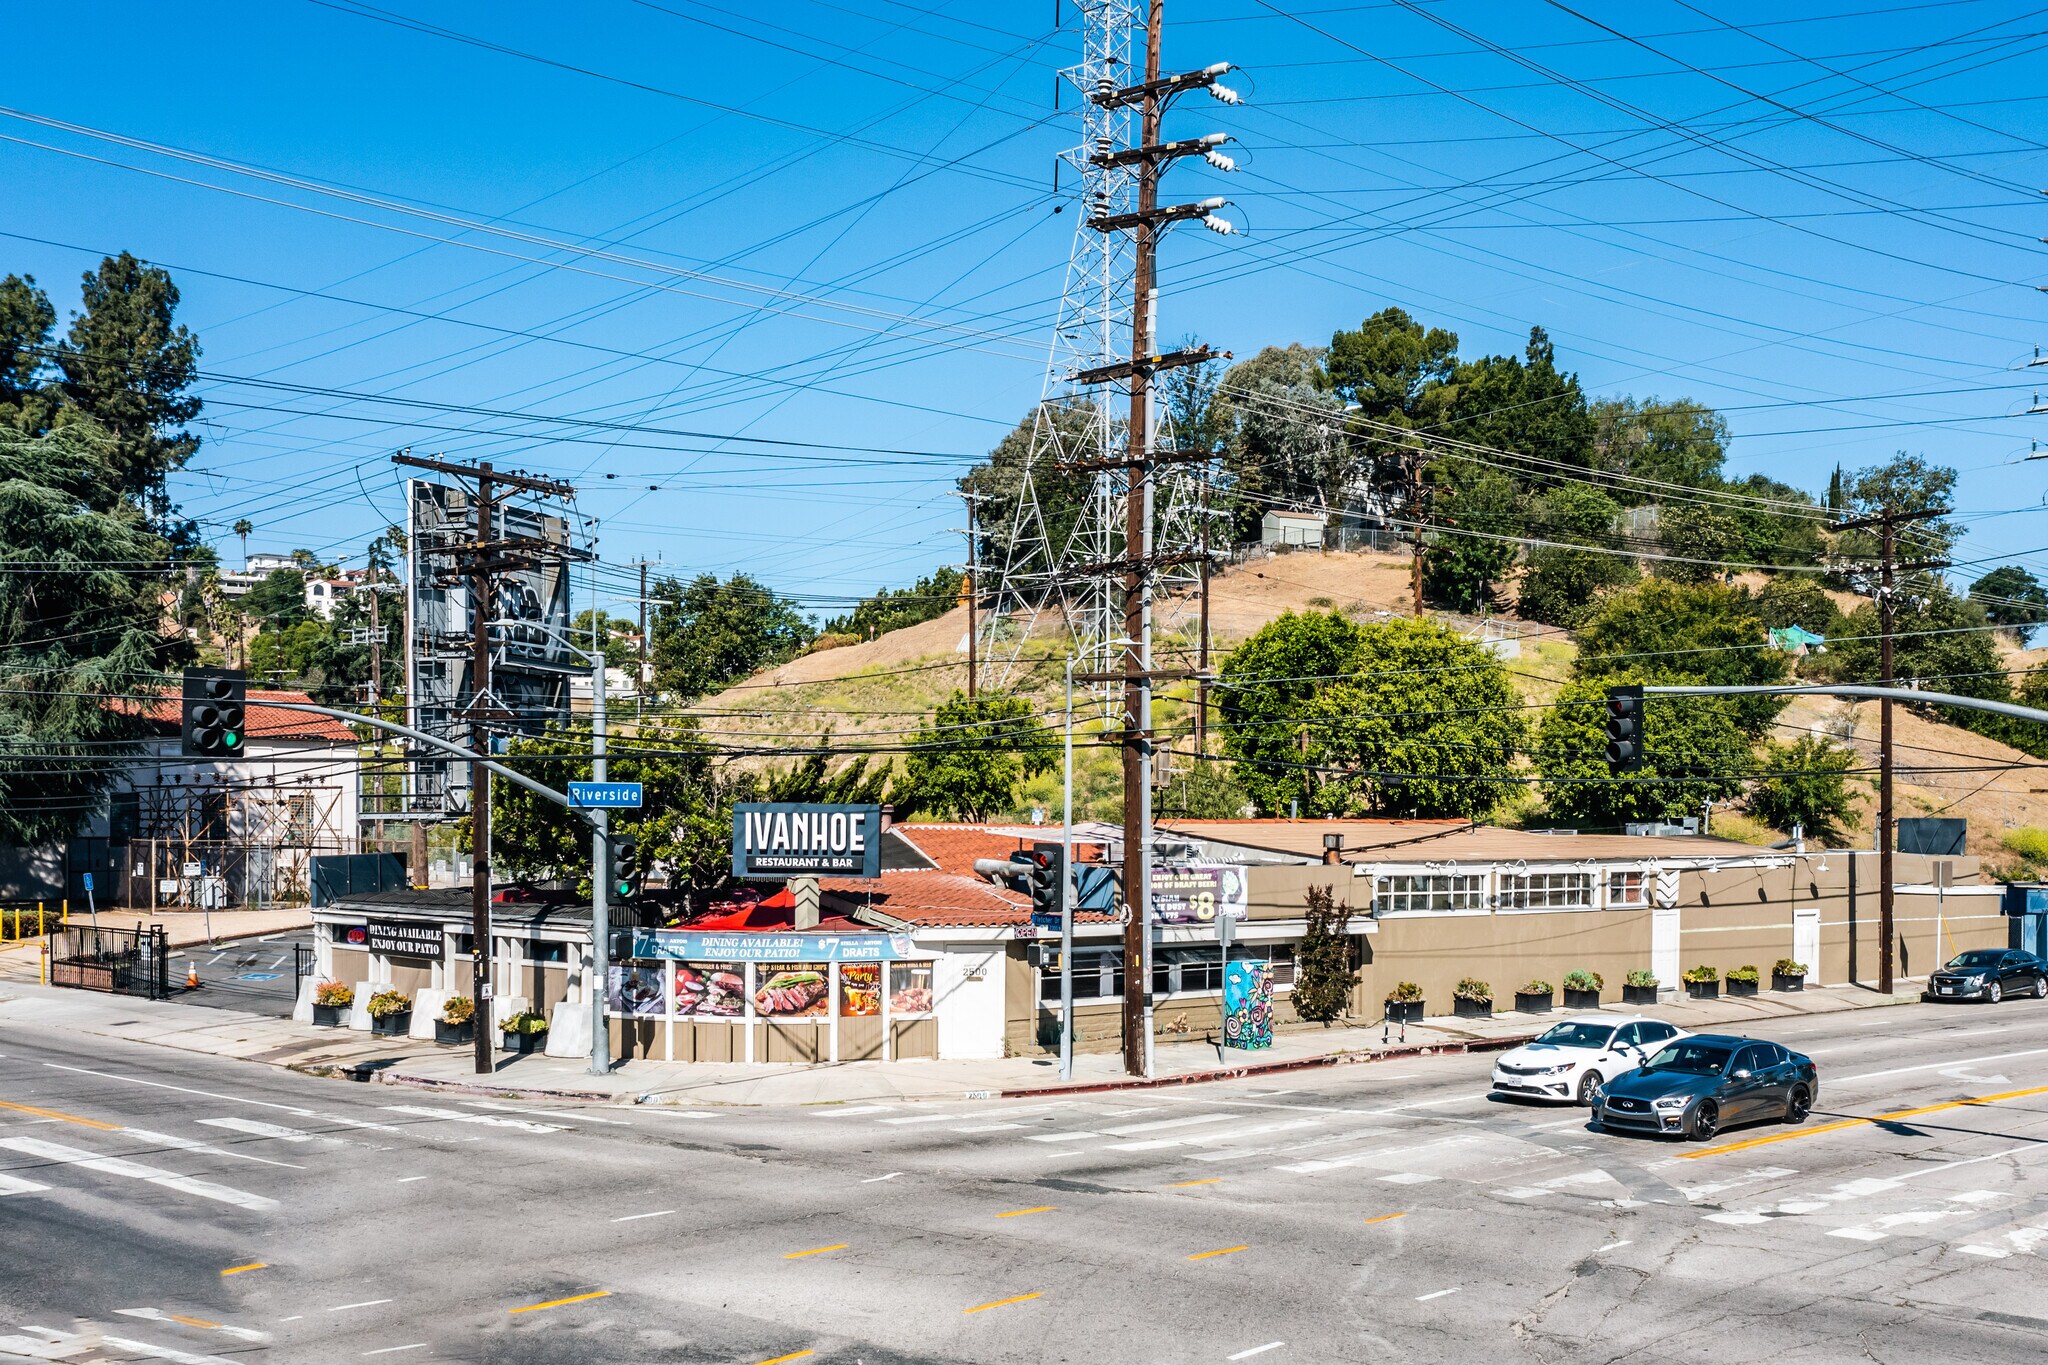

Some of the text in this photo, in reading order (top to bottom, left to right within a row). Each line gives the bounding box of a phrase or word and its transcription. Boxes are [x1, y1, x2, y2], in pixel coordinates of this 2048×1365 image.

[572, 788, 638, 802] Riverside
[745, 812, 866, 852] IVANHOE
[755, 857, 853, 867] RESTAURANT & BAR
[1152, 873, 1213, 882] ENJOY OUR GREAT
[1164, 881, 1174, 889] OF
[1174, 881, 1197, 889] DRAFT
[1198, 880, 1218, 888] BEER!
[1151, 894, 1180, 903] LYSIAN
[1189, 891, 1215, 920] $8
[1166, 903, 1187, 911] DUST
[369, 924, 442, 941] DINING AVAILABLE
[1016, 927, 1037, 938] OPEN
[371, 938, 440, 955] ENJOY OUR PATIO
[701, 937, 804, 947] DINING AVAILABLE!
[651, 945, 686, 955] DRAFTS
[704, 947, 801, 959] ENJOY OUR PATIO!
[843, 947, 880, 958] DRAFTS
[848, 971, 873, 983] Party
[963, 967, 988, 976] 2500
